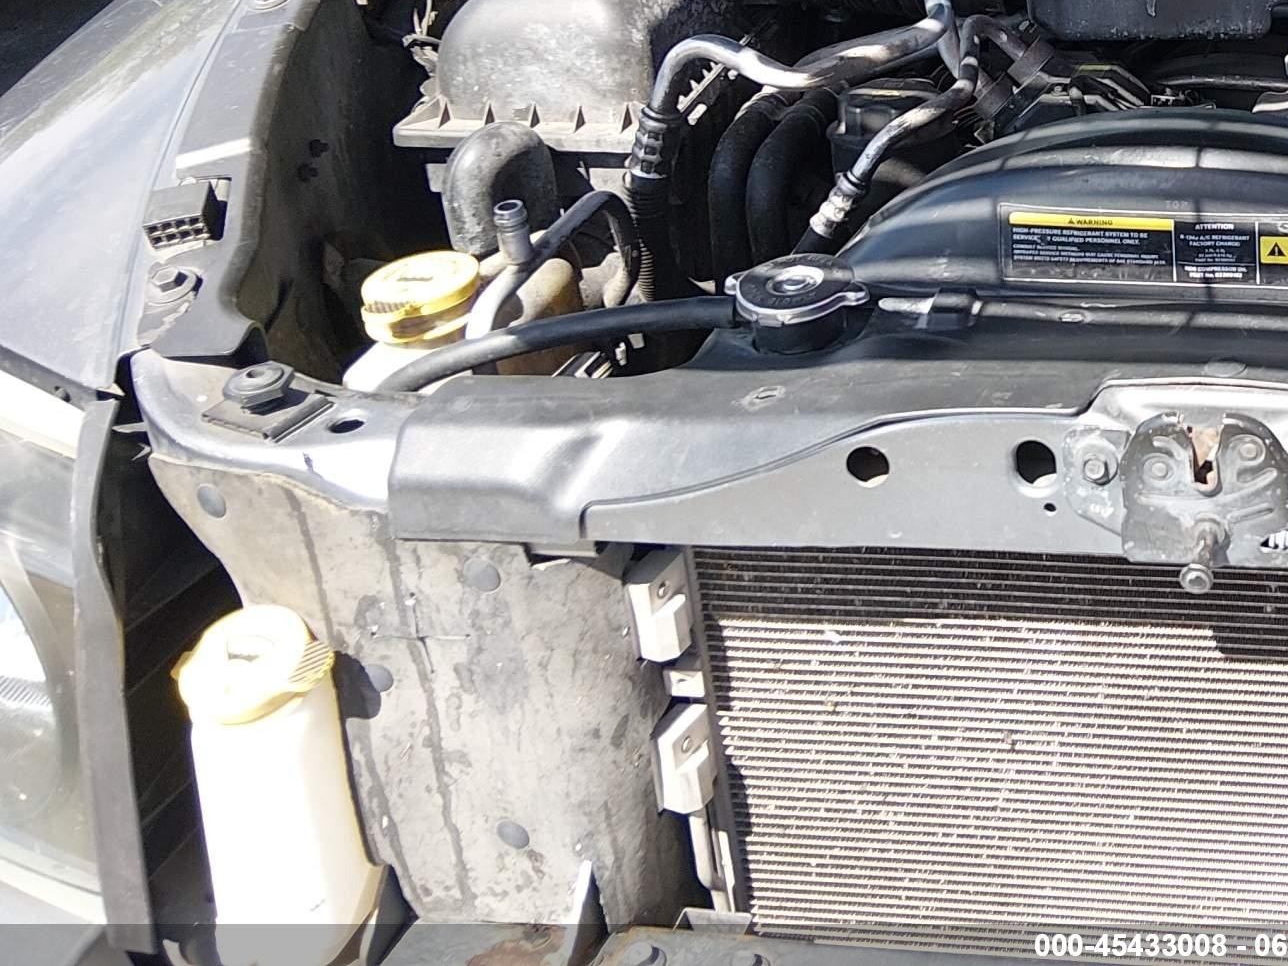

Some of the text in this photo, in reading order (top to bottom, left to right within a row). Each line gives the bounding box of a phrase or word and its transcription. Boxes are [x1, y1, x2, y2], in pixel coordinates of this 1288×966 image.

[1076, 218, 1113, 226] WARNING
[1012, 227, 1061, 235] HIGH-PRESSURE
[1062, 229, 1104, 237] REFRIGERANT
